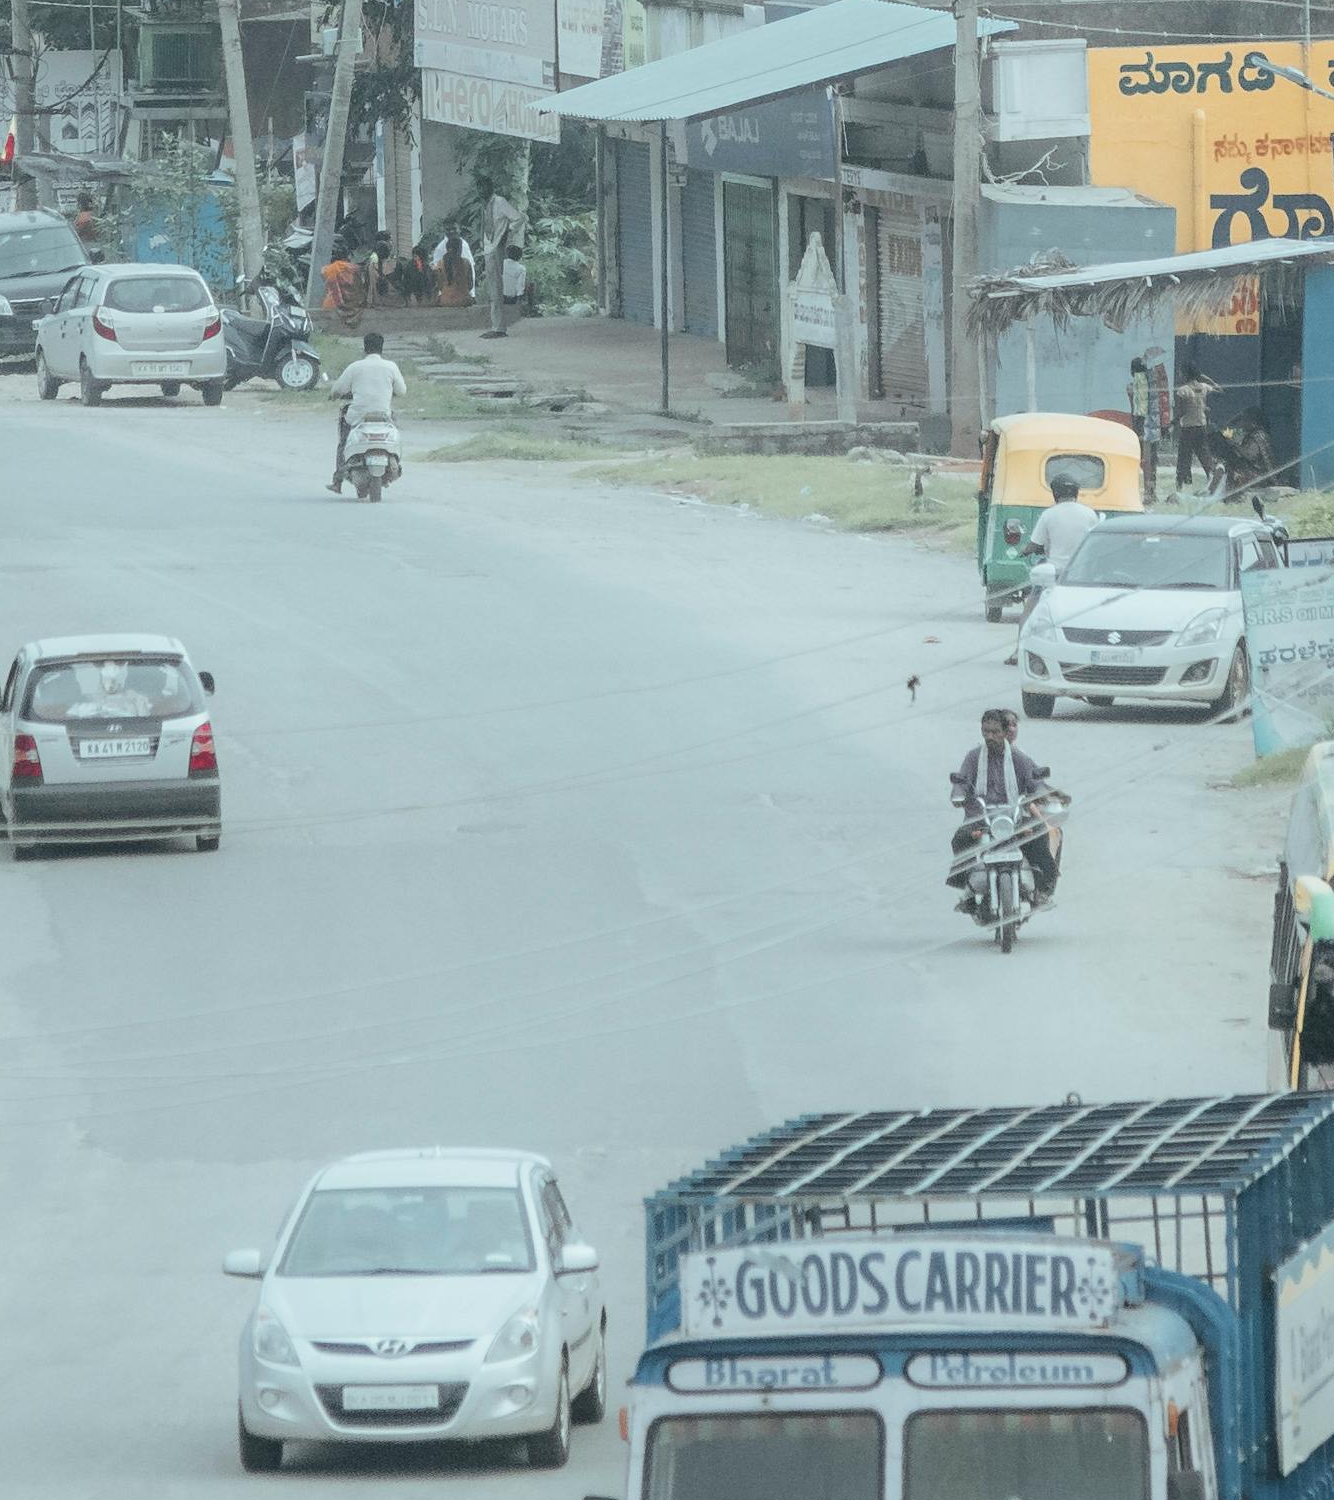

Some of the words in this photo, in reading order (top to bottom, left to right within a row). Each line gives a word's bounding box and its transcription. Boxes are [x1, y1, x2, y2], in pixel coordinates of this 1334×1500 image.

[466, 0, 528, 47] MOTARS
[1119, 50, 1275, 96] ಮಾಗಡಿ
[735, 1250, 890, 1320] GOODS
[895, 1249, 1079, 1318] CARRIER
[705, 1358, 839, 1387] Bharat
[929, 1356, 1094, 1384] Petroleum
